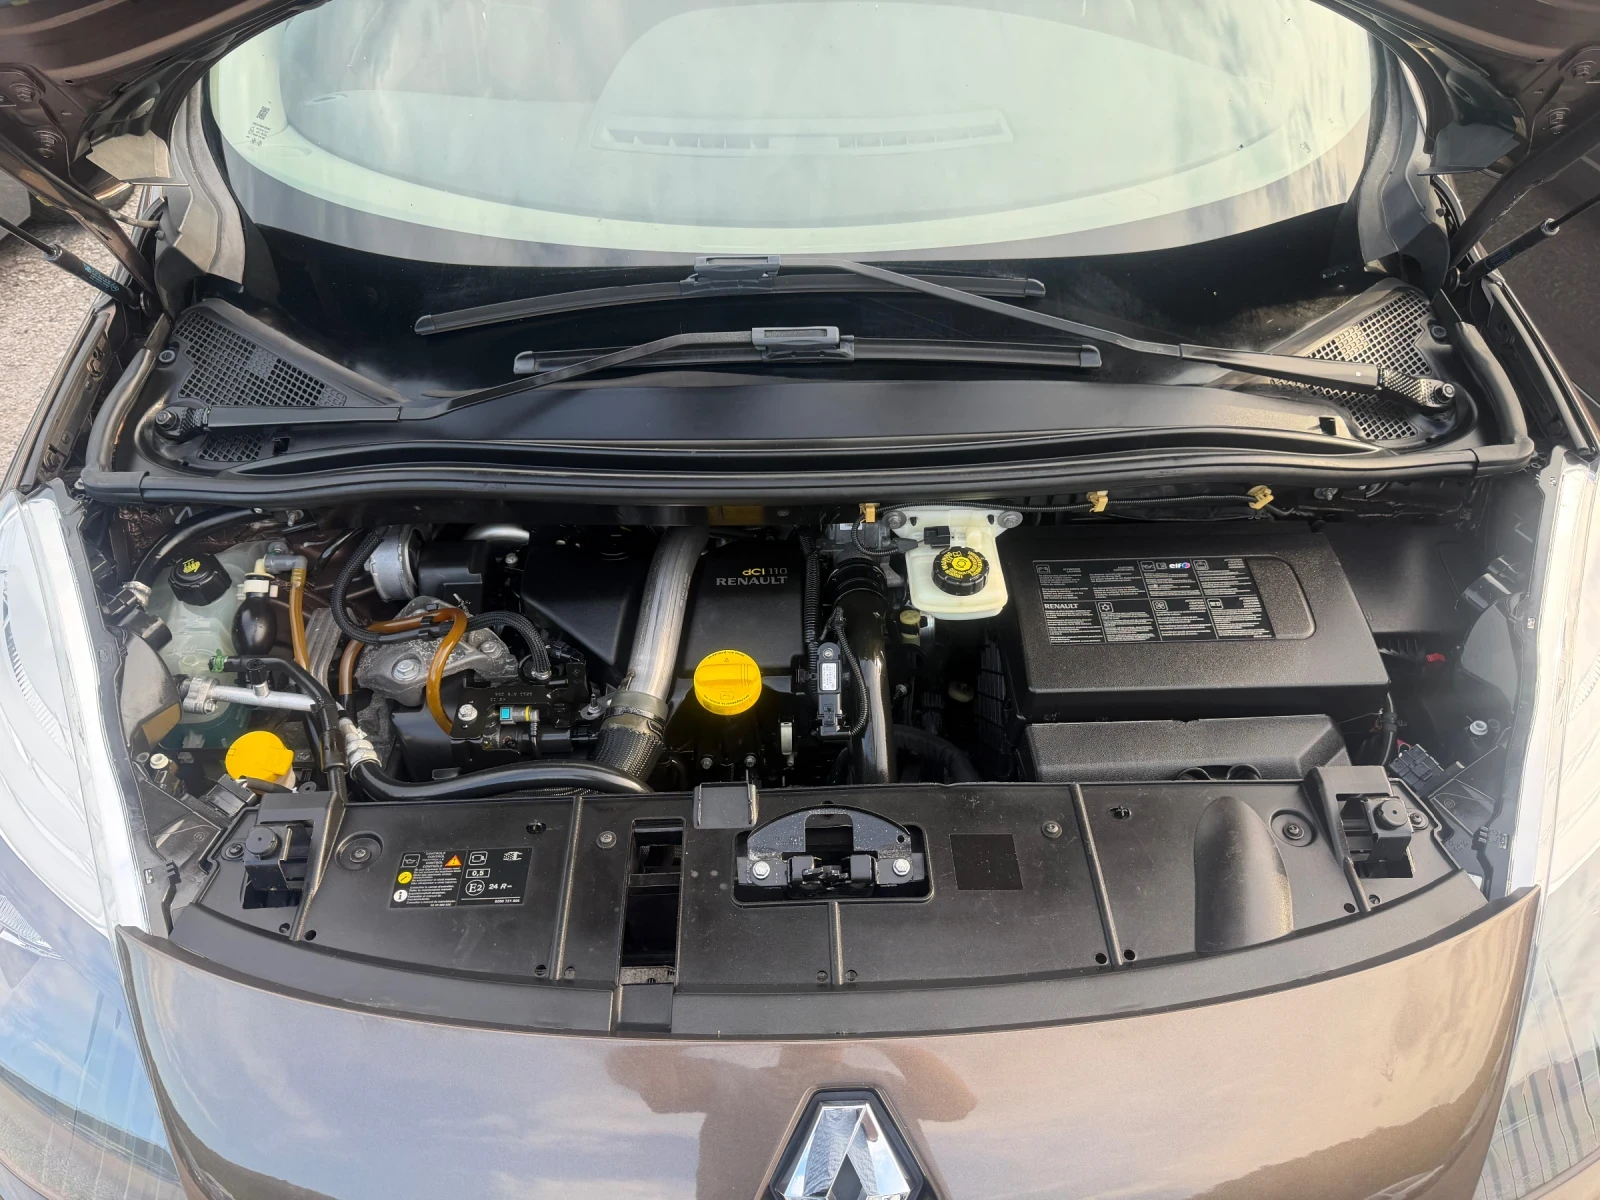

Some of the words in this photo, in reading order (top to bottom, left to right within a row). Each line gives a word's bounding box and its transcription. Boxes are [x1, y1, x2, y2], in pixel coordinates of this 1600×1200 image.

[769, 567, 788, 575] 110
[716, 576, 788, 586] RENAULT
[468, 883, 483, 893] E2
